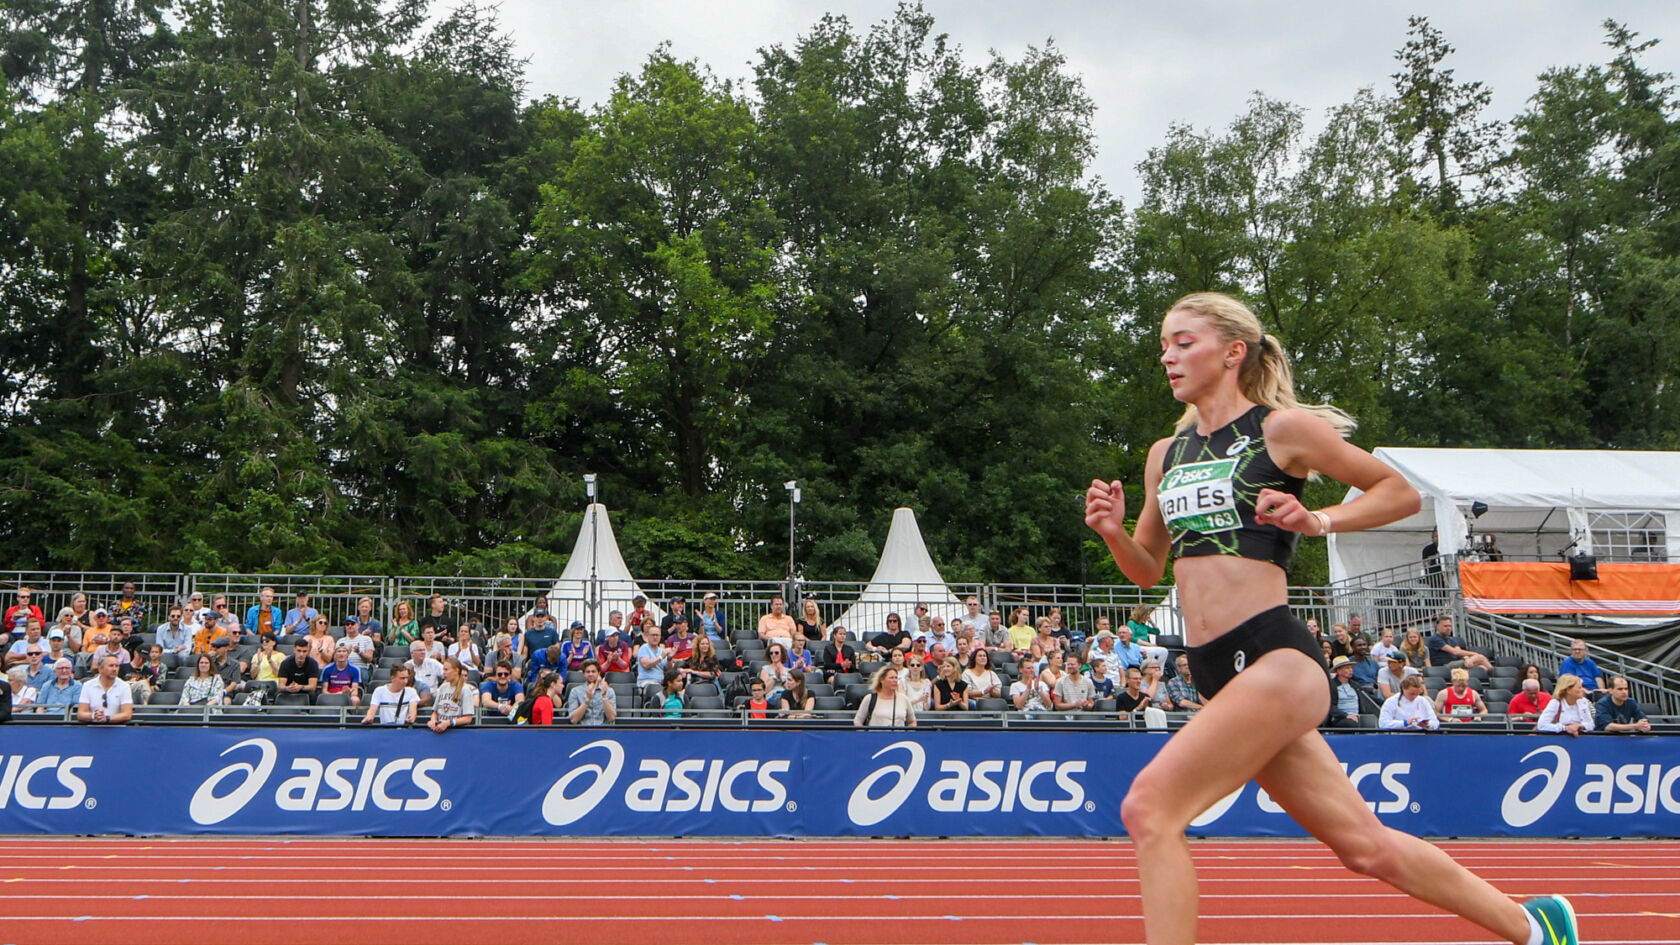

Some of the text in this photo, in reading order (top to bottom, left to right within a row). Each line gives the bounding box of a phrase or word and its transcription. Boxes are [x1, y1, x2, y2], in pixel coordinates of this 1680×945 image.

[1181, 468, 1214, 483] asics
[1197, 486, 1225, 509] Es
[1206, 512, 1234, 528] 163
